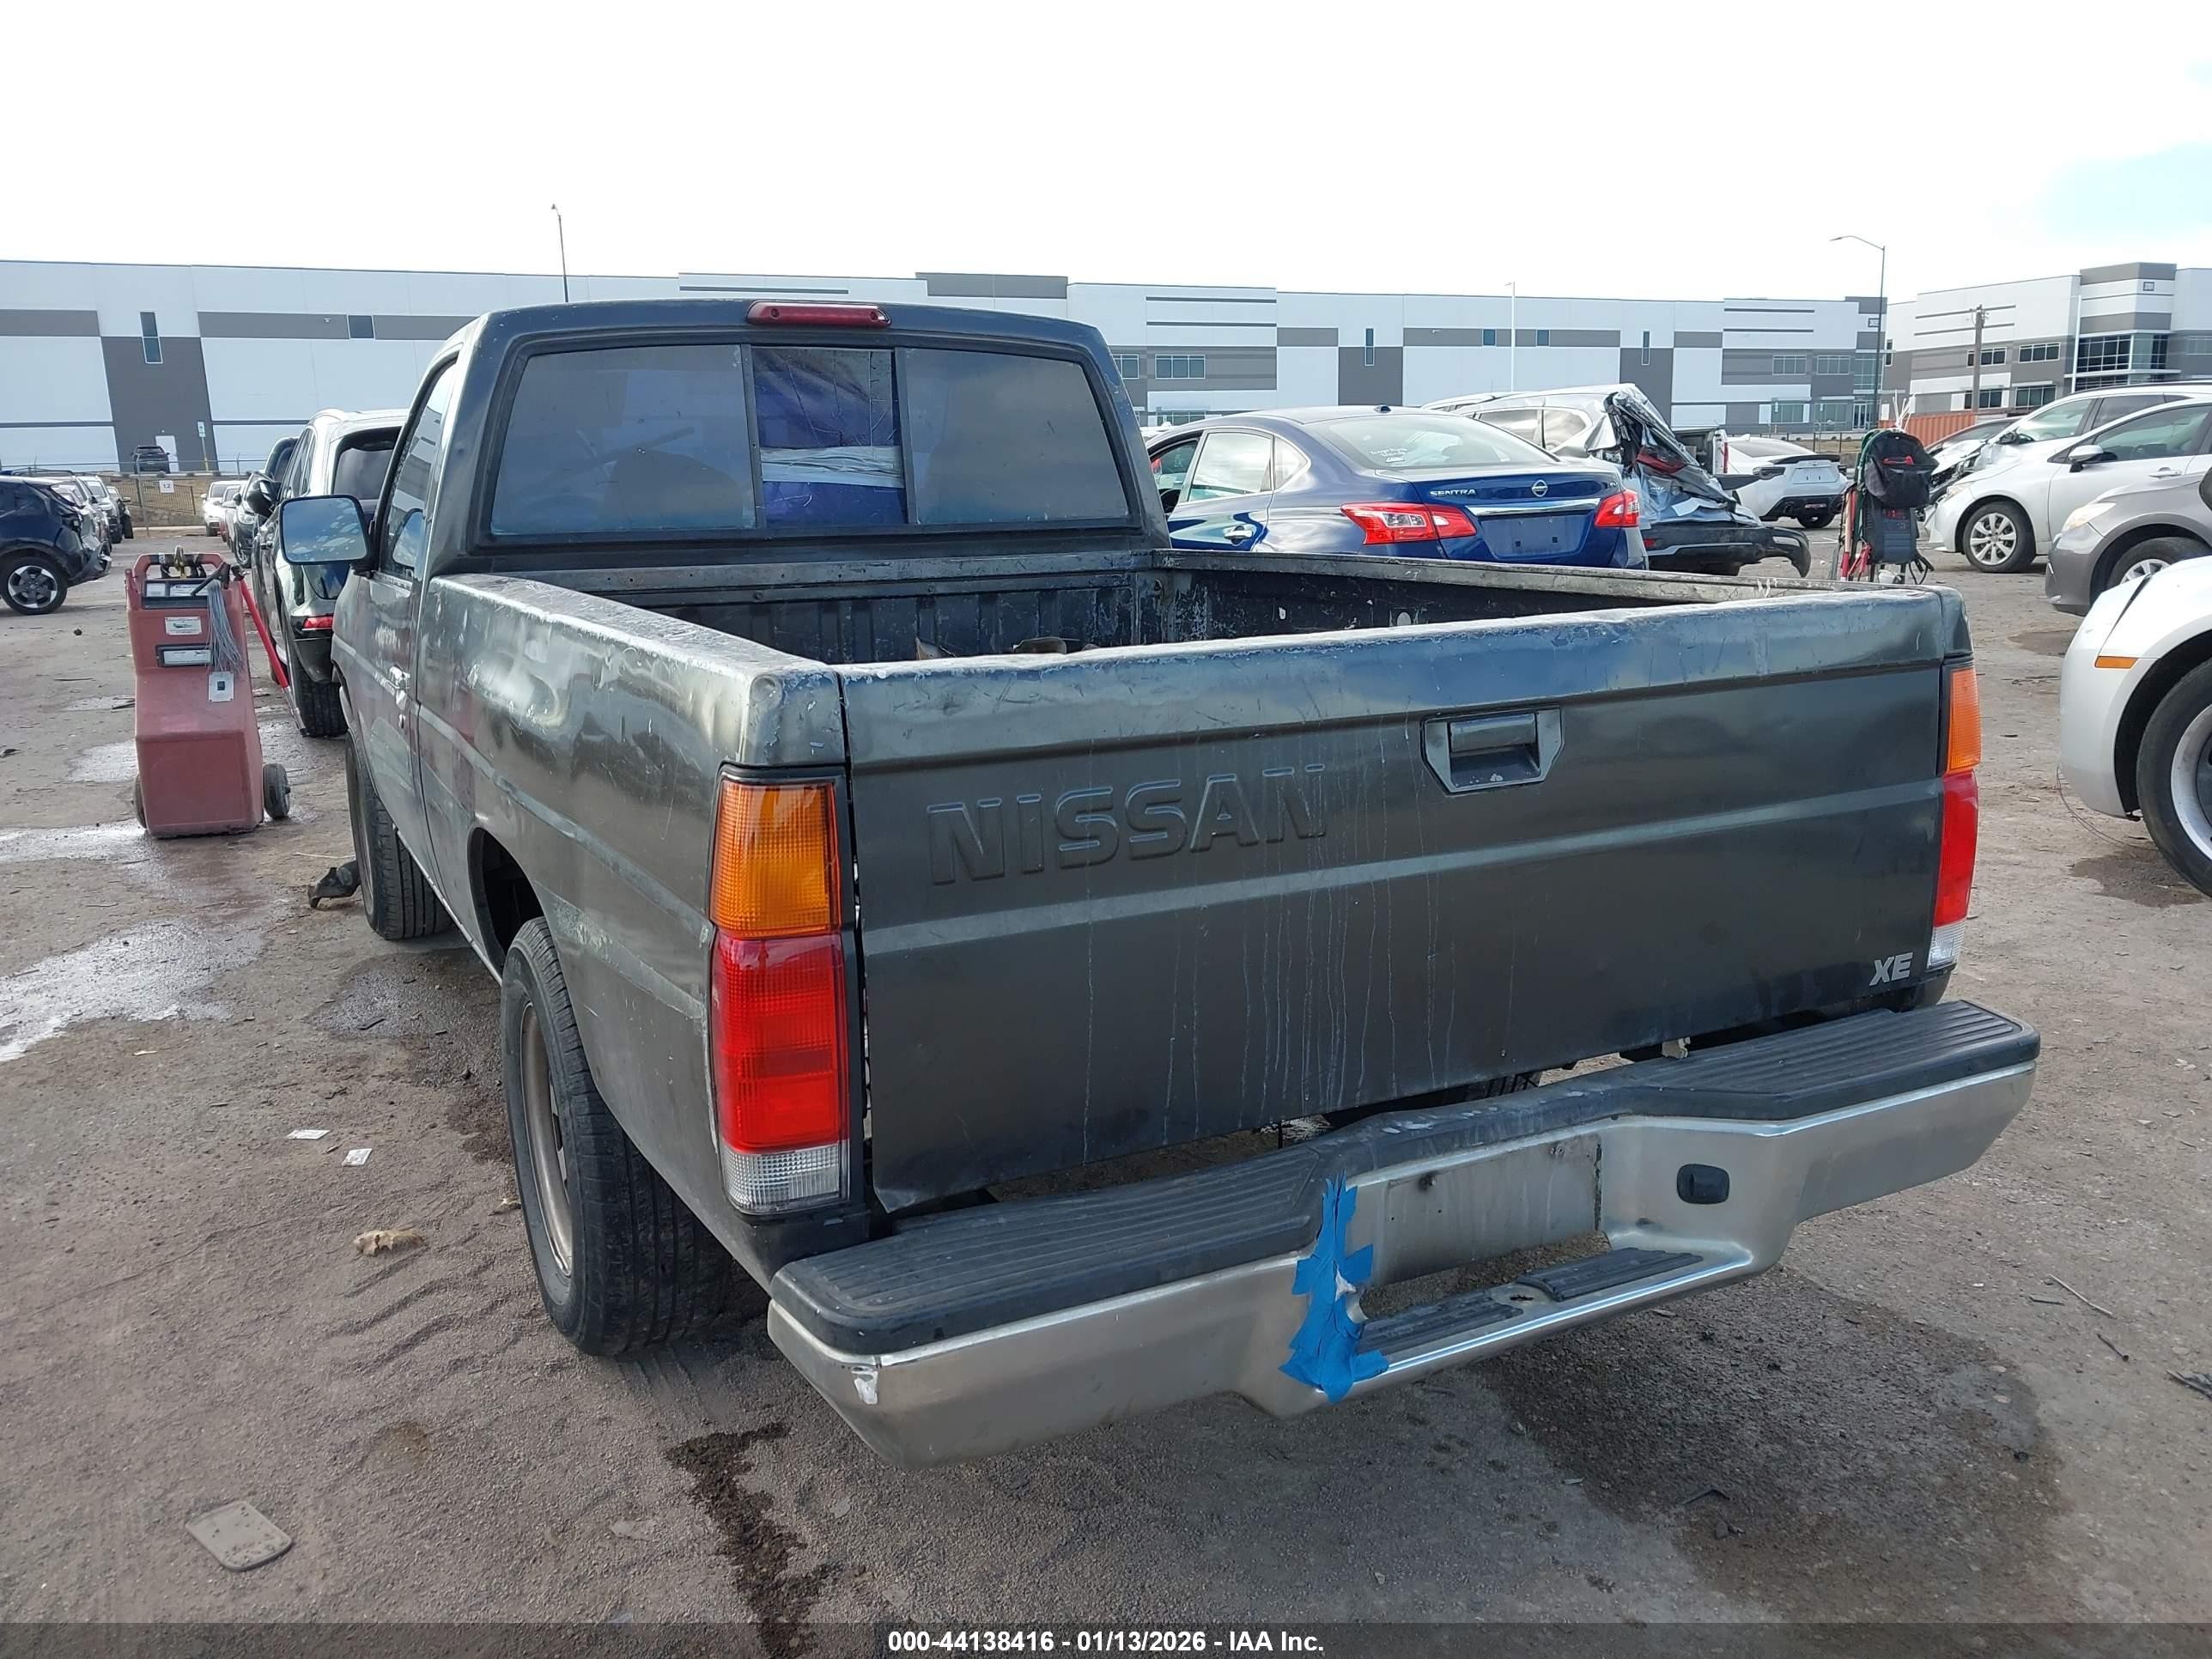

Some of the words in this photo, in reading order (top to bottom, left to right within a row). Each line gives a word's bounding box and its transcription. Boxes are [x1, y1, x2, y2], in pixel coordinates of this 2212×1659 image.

[1429, 489, 1477, 497] SENTRA
[927, 763, 1327, 885] NISSAN
[1869, 951, 1914, 987] XE
